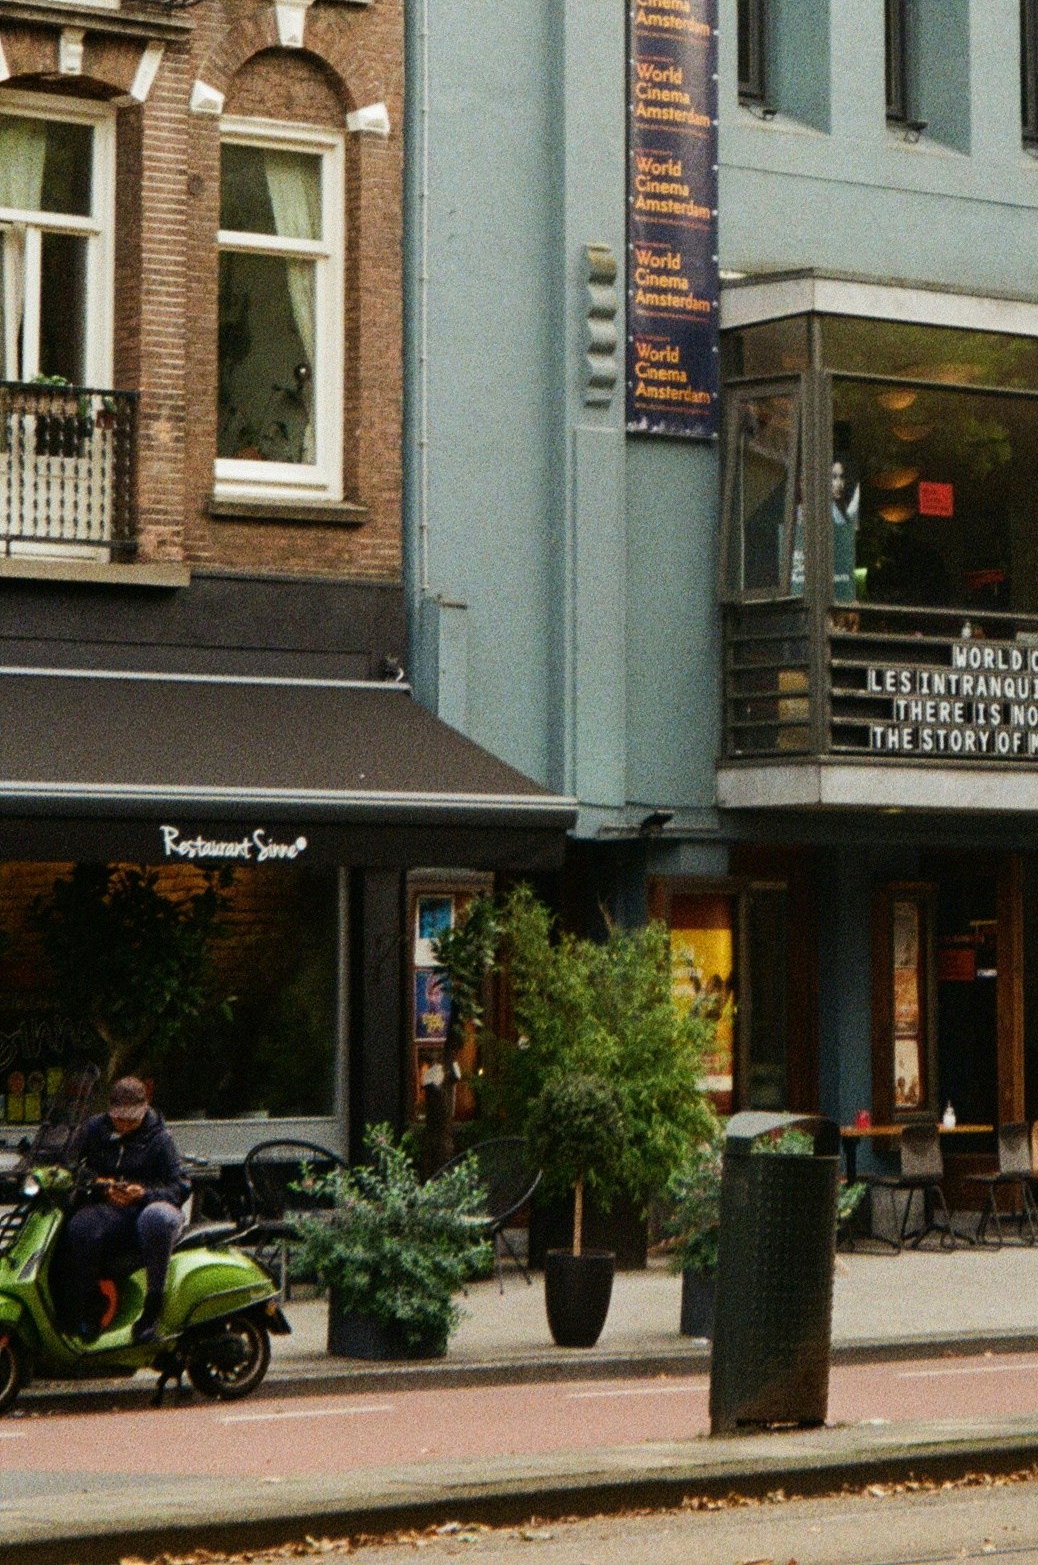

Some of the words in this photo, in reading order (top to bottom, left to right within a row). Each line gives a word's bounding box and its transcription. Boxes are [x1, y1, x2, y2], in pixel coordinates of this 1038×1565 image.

[635, 8, 711, 36] Amsterdam
[636, 62, 683, 85] World
[635, 81, 691, 105] Cinema
[635, 100, 711, 127] Amsterdam
[635, 154, 682, 177] World
[634, 174, 690, 197] Cinema
[635, 194, 711, 220] Amsterdam
[635, 249, 682, 270] World
[634, 268, 689, 290] Cinema
[634, 288, 711, 313] Amsterdam
[635, 342, 680, 363] World
[634, 361, 687, 383] Cinema
[635, 380, 711, 404] Amsterdam
[955, 647, 1022, 670] WORLD
[870, 671, 911, 693] LES
[897, 699, 964, 722] THERE
[977, 704, 1000, 726] IS
[1012, 705, 1038, 727] NO
[873, 726, 913, 749] THE
[921, 728, 990, 753] STORY
[999, 731, 1025, 754] OF
[160, 825, 253, 859] Restaurant
